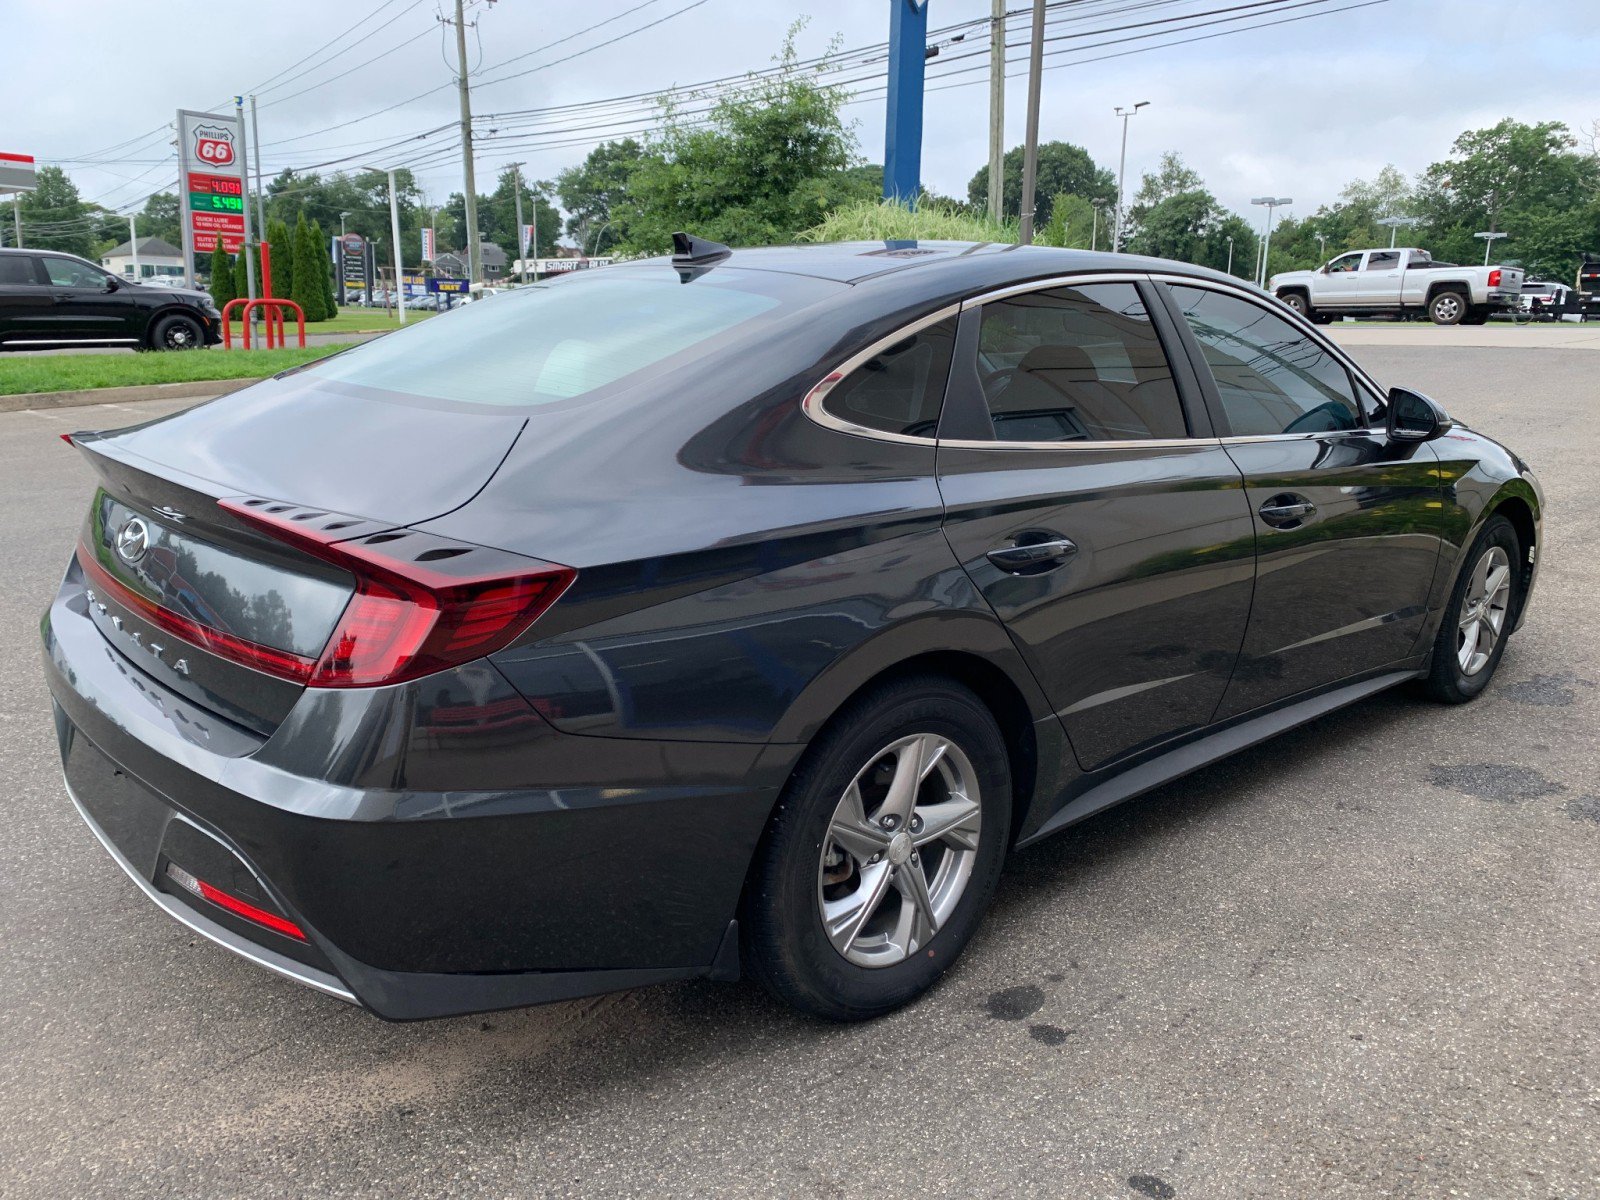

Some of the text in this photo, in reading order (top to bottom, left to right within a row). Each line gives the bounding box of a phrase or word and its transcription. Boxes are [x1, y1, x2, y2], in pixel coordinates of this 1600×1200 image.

[199, 130, 229, 141] PHILLIPS
[202, 141, 228, 159] 66
[546, 261, 578, 271] SMART
[86, 589, 190, 676] SONATA
